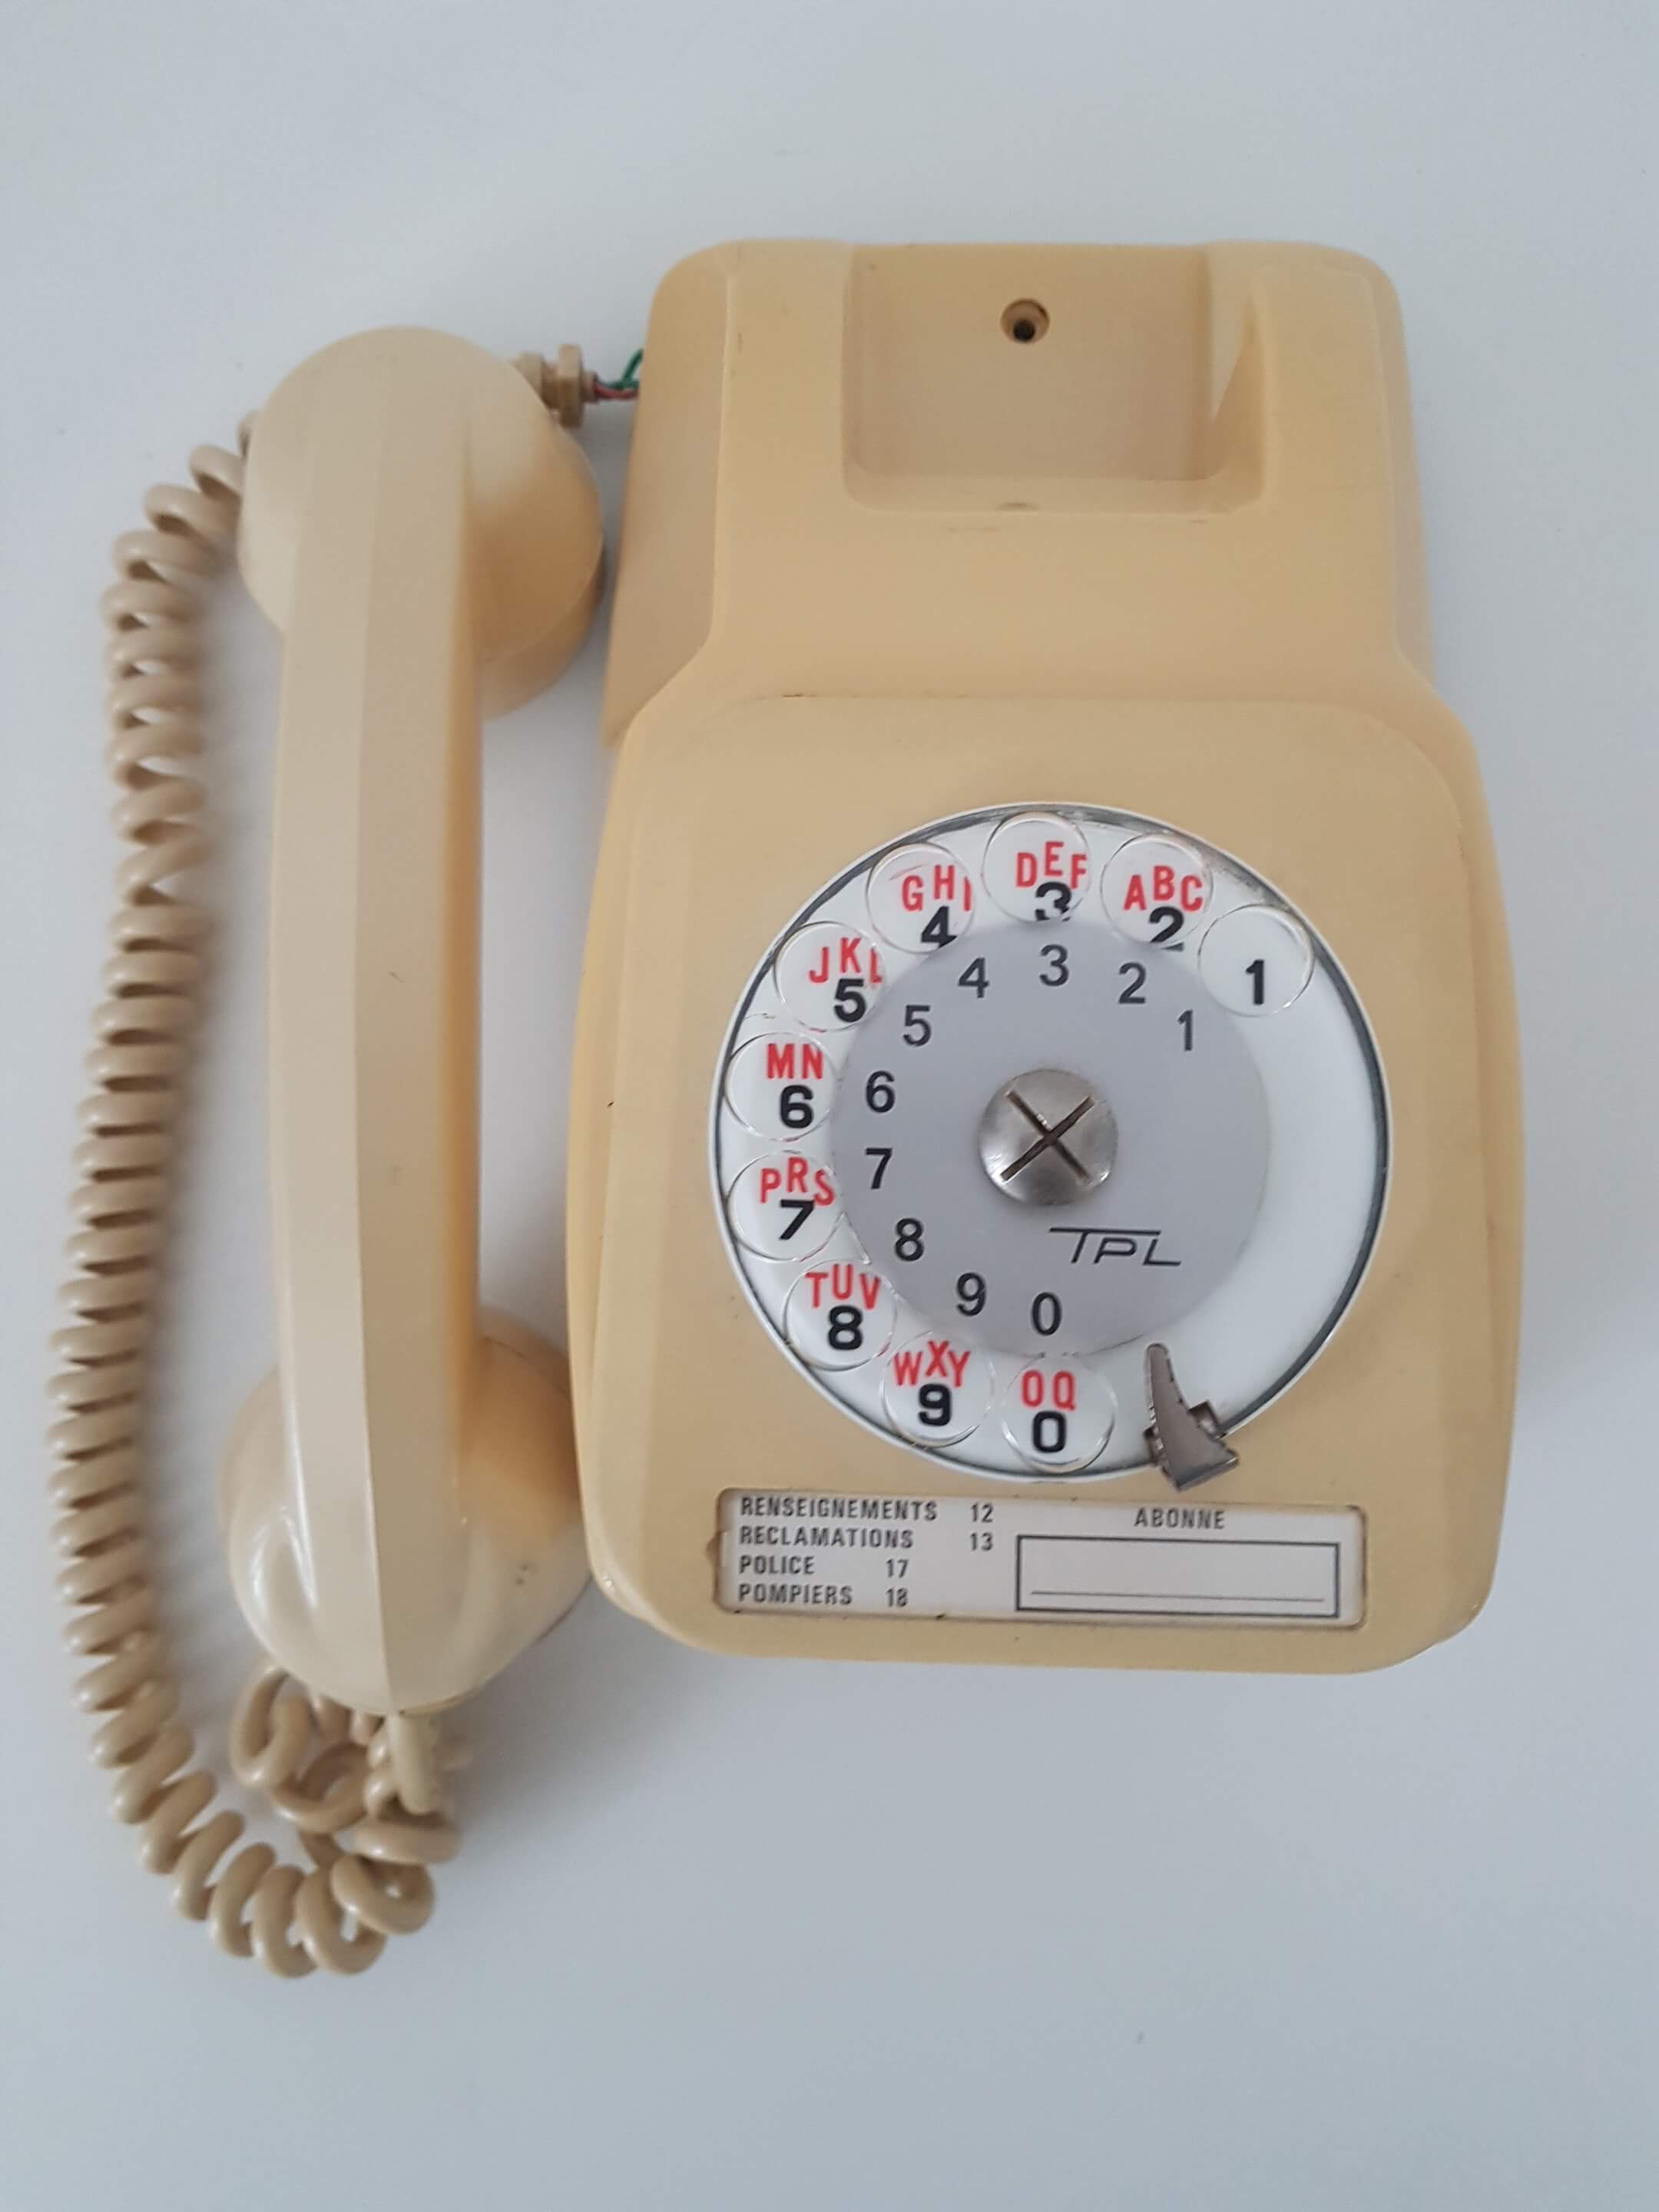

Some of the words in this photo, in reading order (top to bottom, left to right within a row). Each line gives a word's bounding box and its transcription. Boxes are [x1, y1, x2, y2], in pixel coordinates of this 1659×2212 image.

[1015, 841, 1088, 889] DEF
[901, 864, 972, 912] GHI
[1035, 881, 1072, 922] 3
[1123, 865, 1204, 912] ABC
[920, 906, 958, 949] 4
[1147, 906, 1184, 952] 2
[957, 957, 990, 998] 4
[1038, 943, 1070, 987] 3
[1118, 961, 1147, 1005] 2
[1245, 959, 1266, 1005] 1
[833, 978, 867, 1023] 5
[902, 1004, 932, 1047] 5
[1177, 1008, 1194, 1052] 1
[765, 1043, 823, 1080] MN
[779, 1084, 815, 1129] 6
[865, 1070, 896, 1114] 6
[759, 1157, 834, 1207] PRS
[865, 1147, 892, 1190] 7
[779, 1199, 815, 1240] 7
[894, 1217, 925, 1261] 8
[1048, 1226, 1182, 1267] TPL
[805, 1263, 881, 1310] TUV
[956, 1271, 987, 1316] 9
[827, 1305, 863, 1351] 8
[1031, 1291, 1062, 1336] 0
[892, 1339, 971, 1388] WXY
[918, 1382, 952, 1427] 9
[1022, 1369, 1075, 1411] OQ
[1031, 1410, 1067, 1453] 0
[740, 1496, 938, 1522] RENSEIGNEMENTS
[970, 1502, 995, 1523] 12
[1134, 1507, 1226, 1530] ABONNE
[738, 1525, 914, 1549] RECLAMATIONS
[970, 1532, 994, 1551] 13
[738, 1554, 816, 1575] POLICE
[886, 1558, 910, 1578] 17
[738, 1582, 853, 1606] POMPIERS
[886, 1588, 909, 1608] 18
